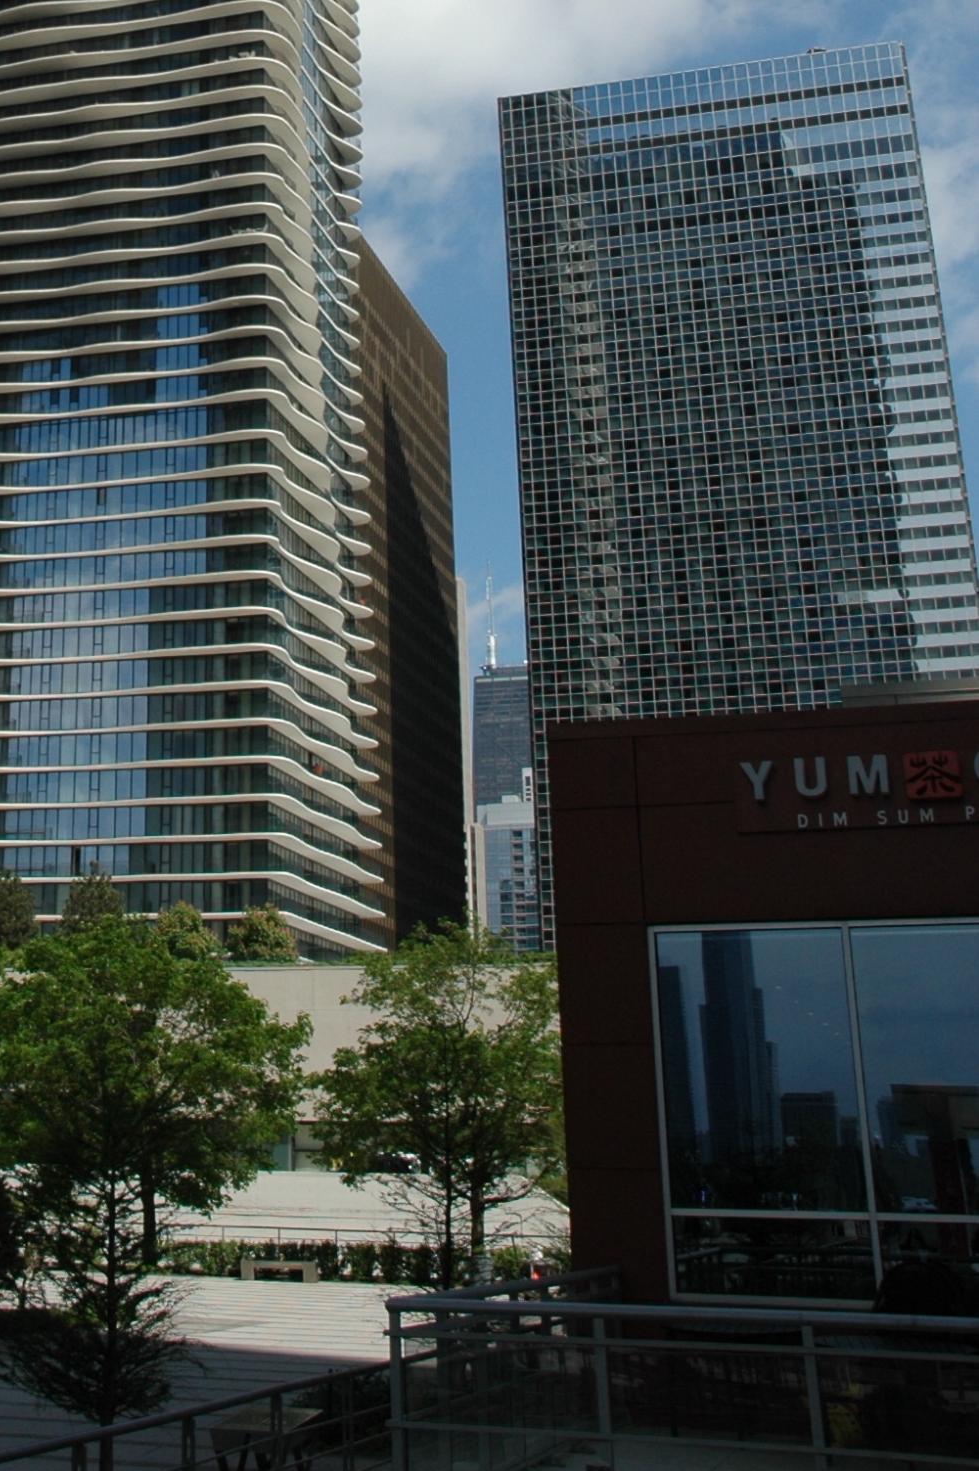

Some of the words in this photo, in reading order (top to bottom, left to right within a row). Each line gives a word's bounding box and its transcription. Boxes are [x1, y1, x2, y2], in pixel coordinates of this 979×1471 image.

[740, 754, 889, 800] YUM
[798, 812, 848, 828] DIM
[877, 808, 934, 825] SUM
